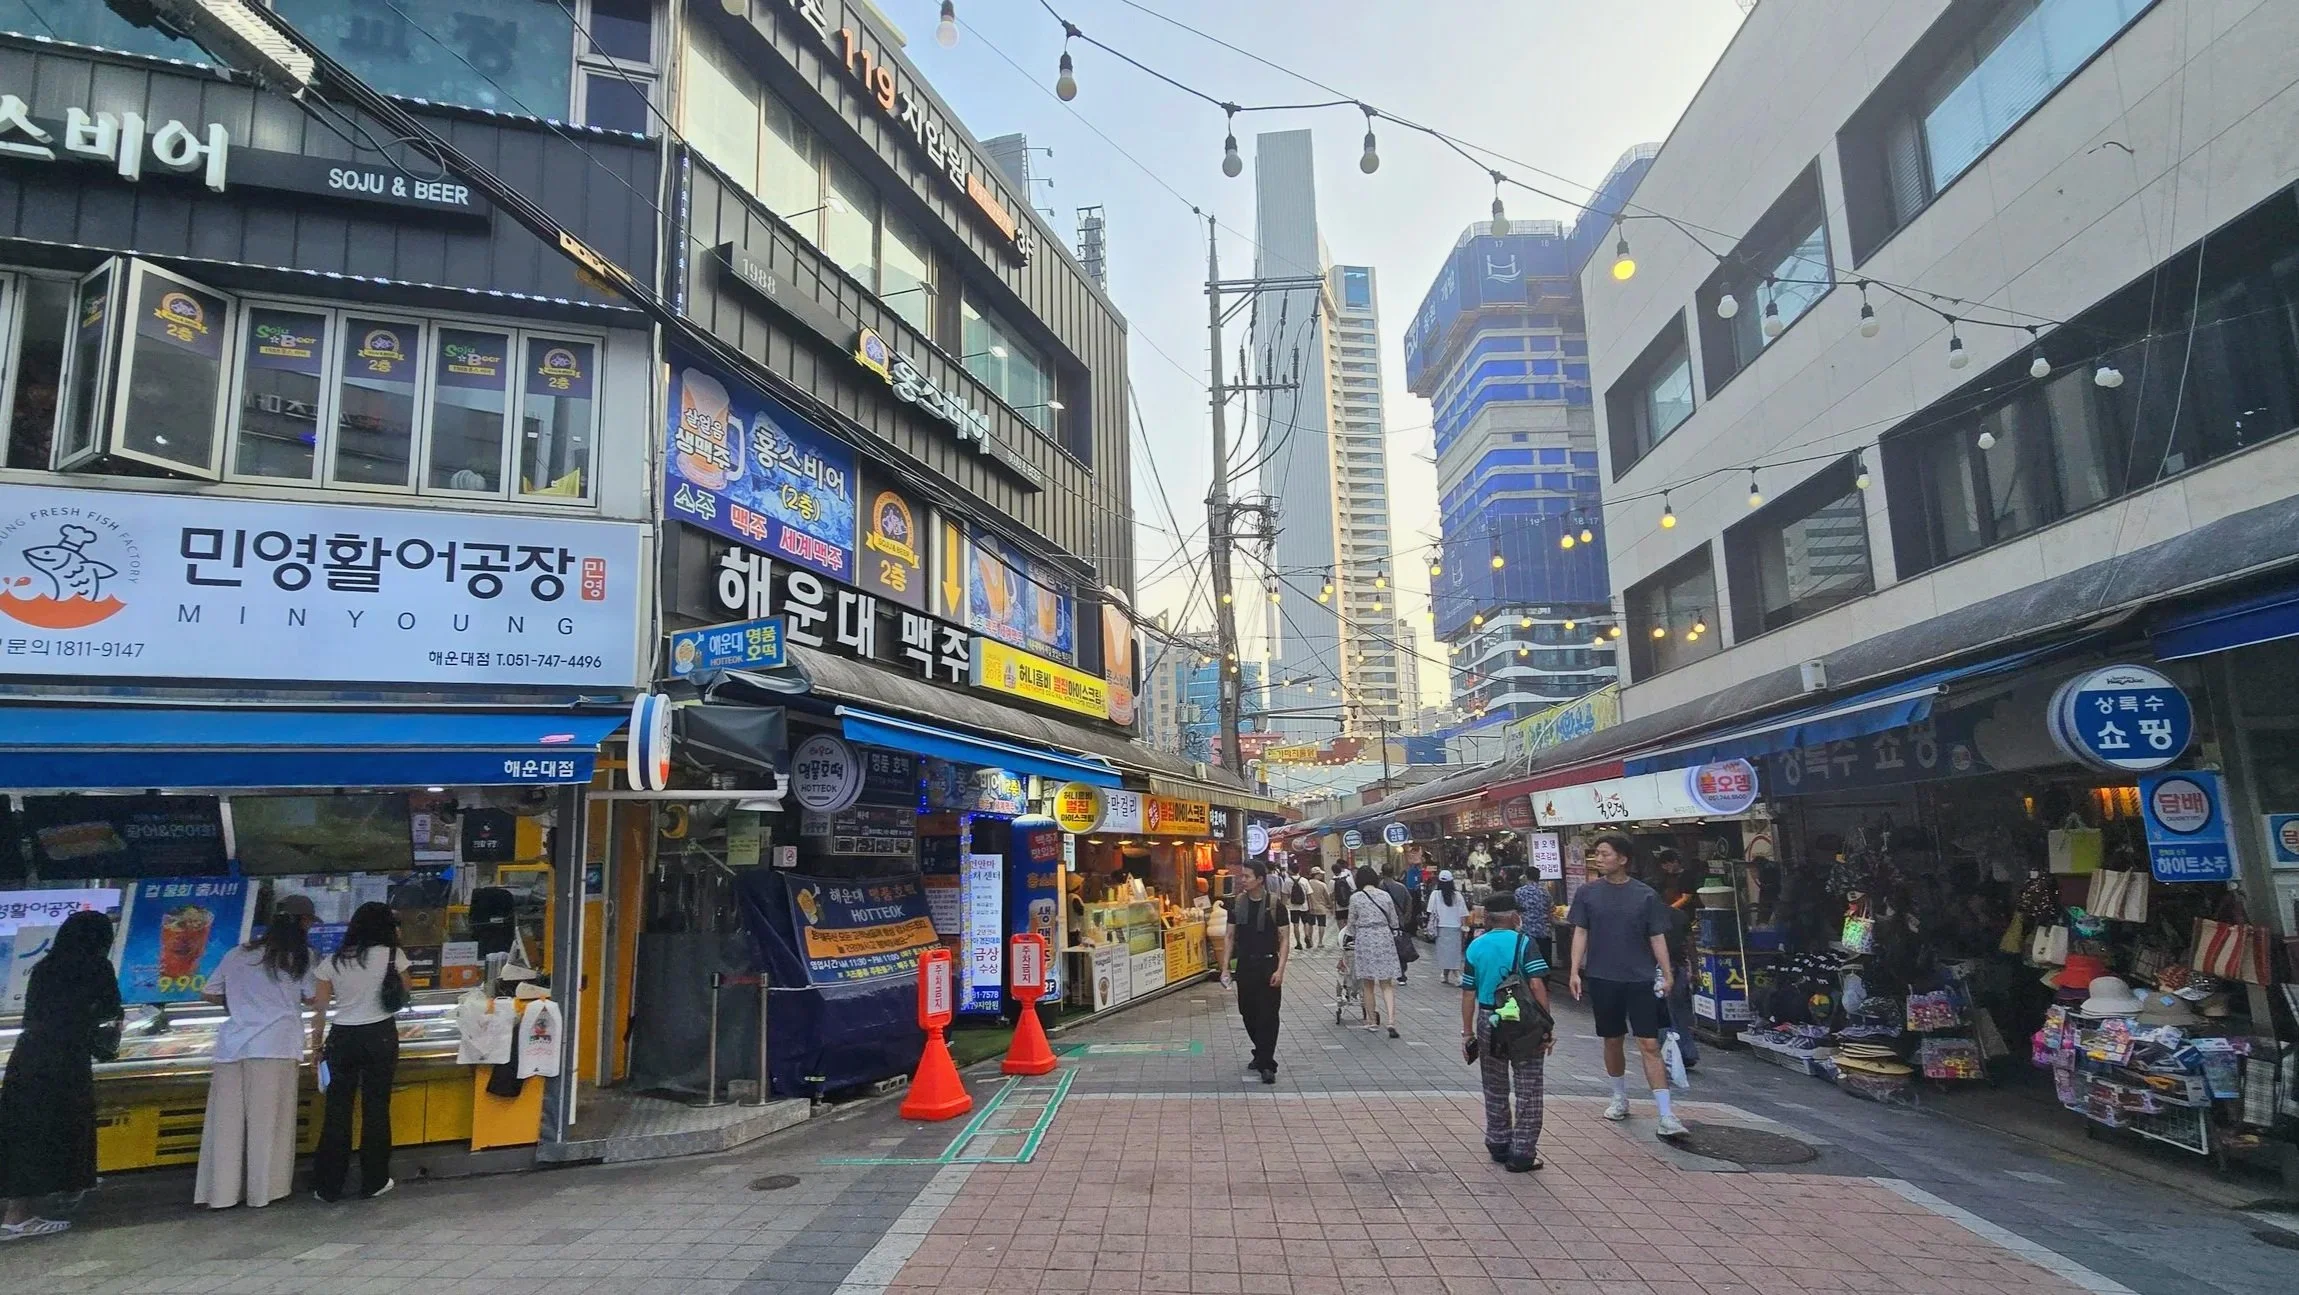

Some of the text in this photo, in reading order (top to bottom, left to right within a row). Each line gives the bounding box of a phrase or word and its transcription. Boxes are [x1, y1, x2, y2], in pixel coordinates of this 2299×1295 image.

[840, 27, 967, 195] 119 지압원
[0, 95, 229, 192] 스비어
[328, 168, 469, 206] SOJU & BEER
[1016, 227, 1035, 261] 3F
[741, 258, 777, 296] 1988
[255, 325, 290, 339] Soju
[444, 344, 476, 357] Soju
[548, 377, 571, 390] 2층
[892, 351, 990, 455] 홍스비어
[685, 408, 726, 441] 살얼음
[675, 427, 732, 470] 생맥주
[753, 426, 846, 500] 홍스비어
[780, 483, 822, 522] (2층)
[674, 483, 844, 571] 소주 맥주 세계맥주
[0, 507, 141, 585] UNG FRESH FISH FACTORY
[179, 526, 577, 603] 민영활어공장
[583, 560, 604, 598] 민영
[880, 559, 907, 593] 2층
[718, 547, 970, 684] 해운대 맥주
[0, 638, 145, 658] 문의 1811-9147
[709, 625, 776, 656] 해운대 명품
[428, 650, 603, 668] 해운대점 T.051-747-4496
[710, 643, 777, 666] HOTTEOK 호떡
[2095, 695, 2164, 714] 상록수
[2098, 719, 2173, 750] 쇼핑
[1873, 724, 1938, 770] 쇼핑
[504, 759, 575, 778] 해운대점
[798, 760, 843, 780] 명품호떡
[872, 753, 890, 773] 명품
[800, 784, 837, 793] HOTTEOK
[955, 767, 1002, 797] 홍스비어
[1700, 774, 1750, 794] 불오뎅
[1066, 800, 1089, 813] 벌집
[1107, 795, 1137, 819] 막걸리
[2158, 792, 2204, 814] 담배
[1061, 814, 1095, 823] 아이스크림
[1031, 847, 1059, 861] 맛있는
[2157, 855, 2228, 875] 하이트소주
[145, 885, 161, 897] 컵
[164, 884, 192, 898] 물회
[829, 888, 865, 904] 해운대
[851, 905, 907, 923] HOTTEOK
[810, 959, 838, 971] 영업시간
[849, 957, 867, 967] 11:30
[883, 953, 900, 962] 11:00
[974, 947, 1000, 962] 금상
[1021, 945, 1031, 983] 주차금지
[979, 963, 998, 974] 수상
[158, 974, 208, 994] 9.90
[935, 964, 943, 1010] 주차금지
[971, 990, 999, 999] 31-7578
